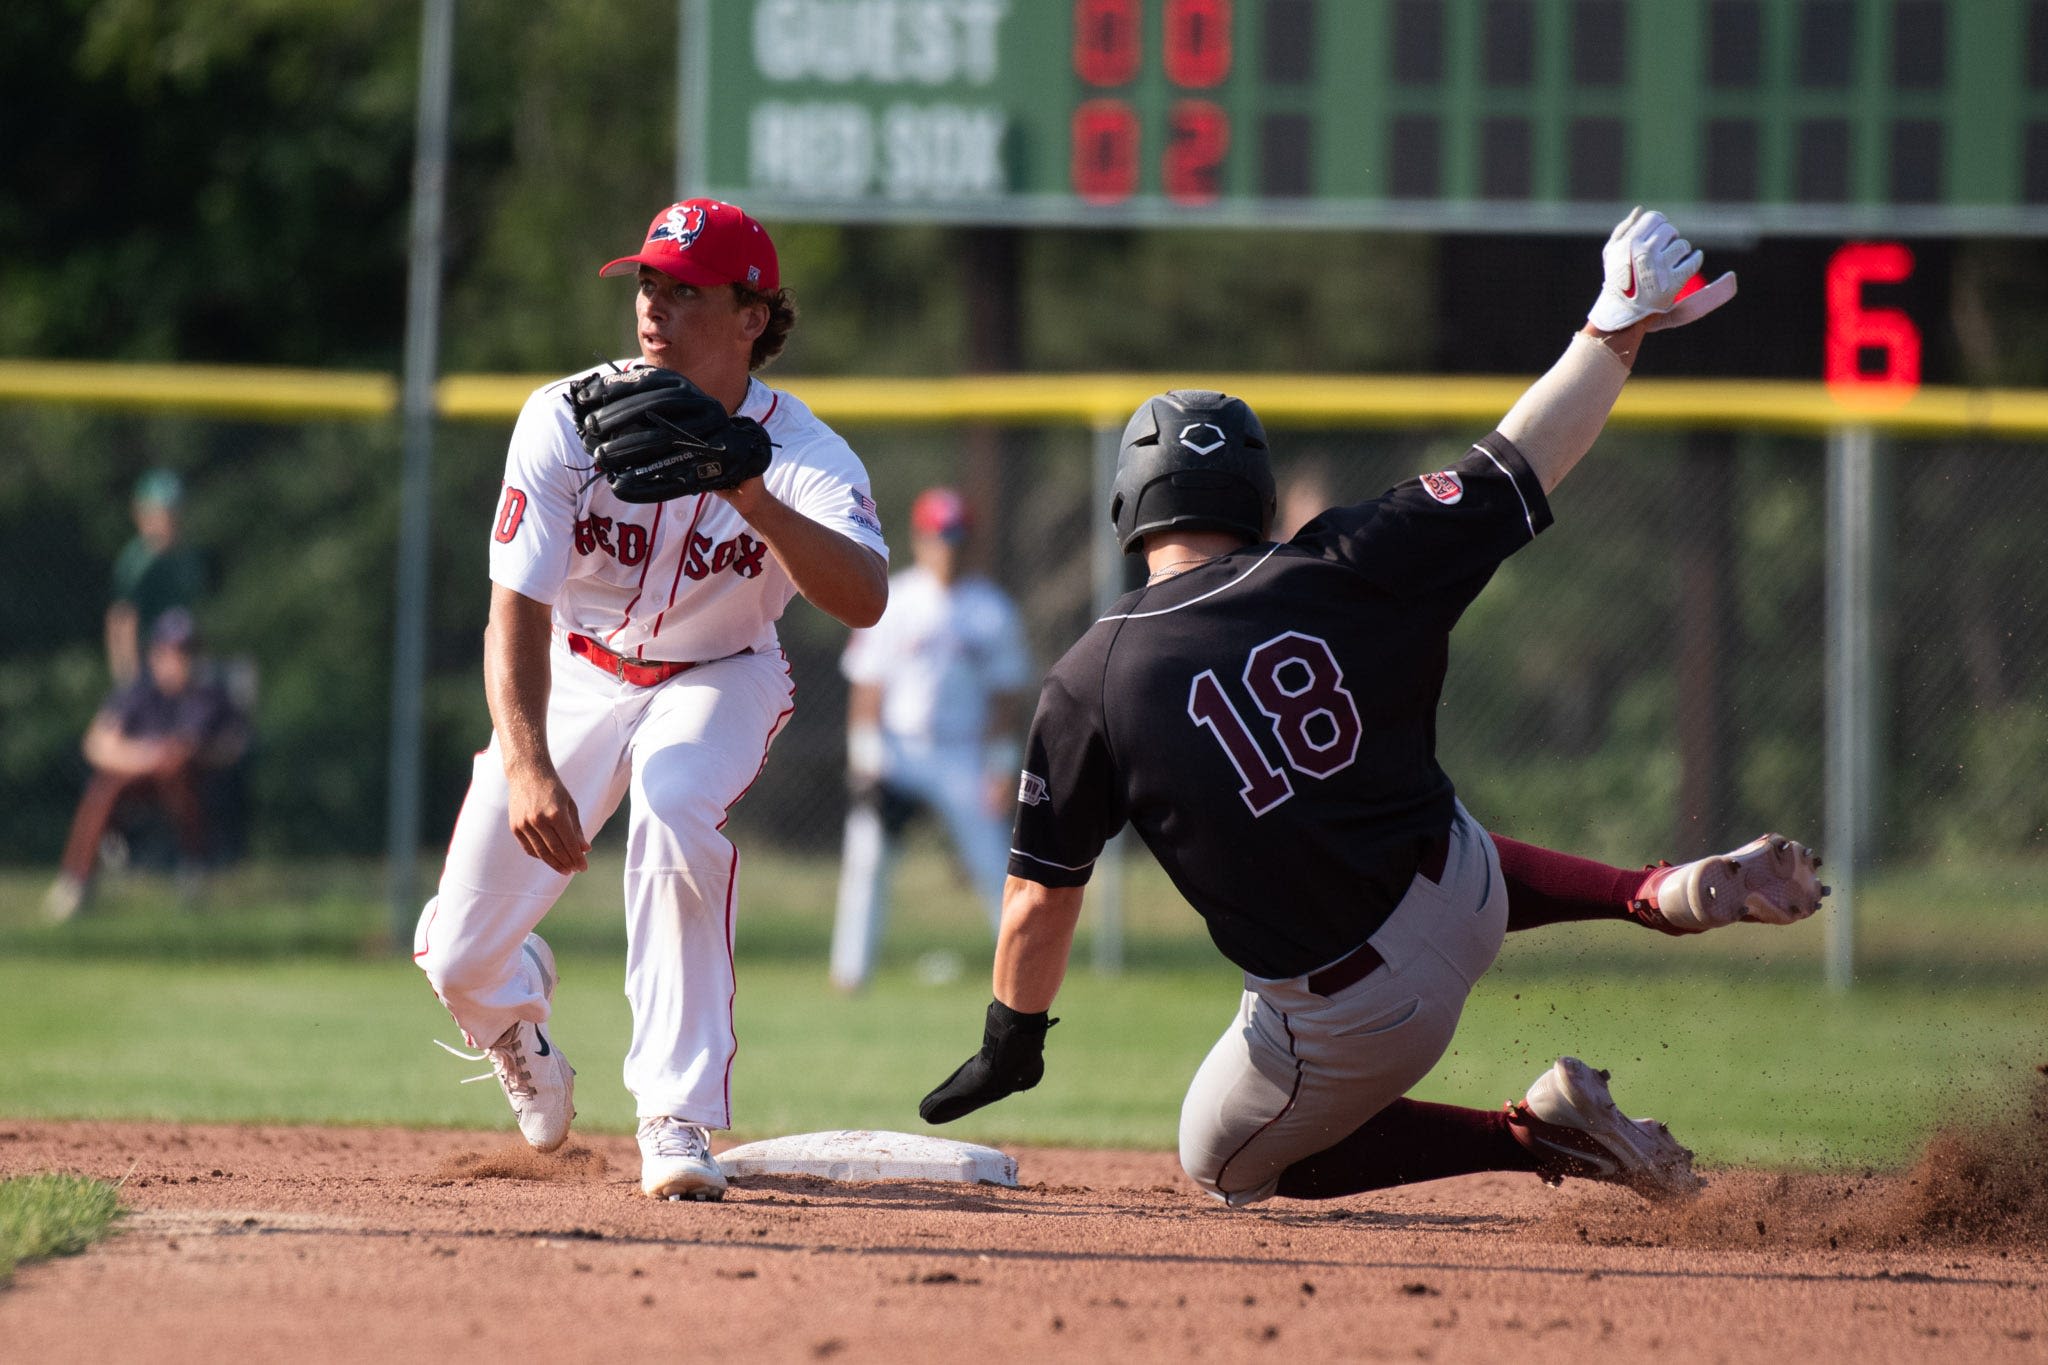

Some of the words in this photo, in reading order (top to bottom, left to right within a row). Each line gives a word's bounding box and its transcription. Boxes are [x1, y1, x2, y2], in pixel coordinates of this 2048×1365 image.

[752, 0, 1006, 83] GUEST
[1074, 0, 1143, 87] 0
[1162, 0, 1232, 87] 0
[750, 102, 872, 199] RED
[882, 102, 1006, 199] SOX
[1071, 100, 1140, 205] 0
[1162, 100, 1231, 206] 2
[1825, 242, 1921, 410] 6
[574, 512, 649, 567] RED
[684, 531, 767, 581] SOX
[1187, 630, 1363, 818] 18
